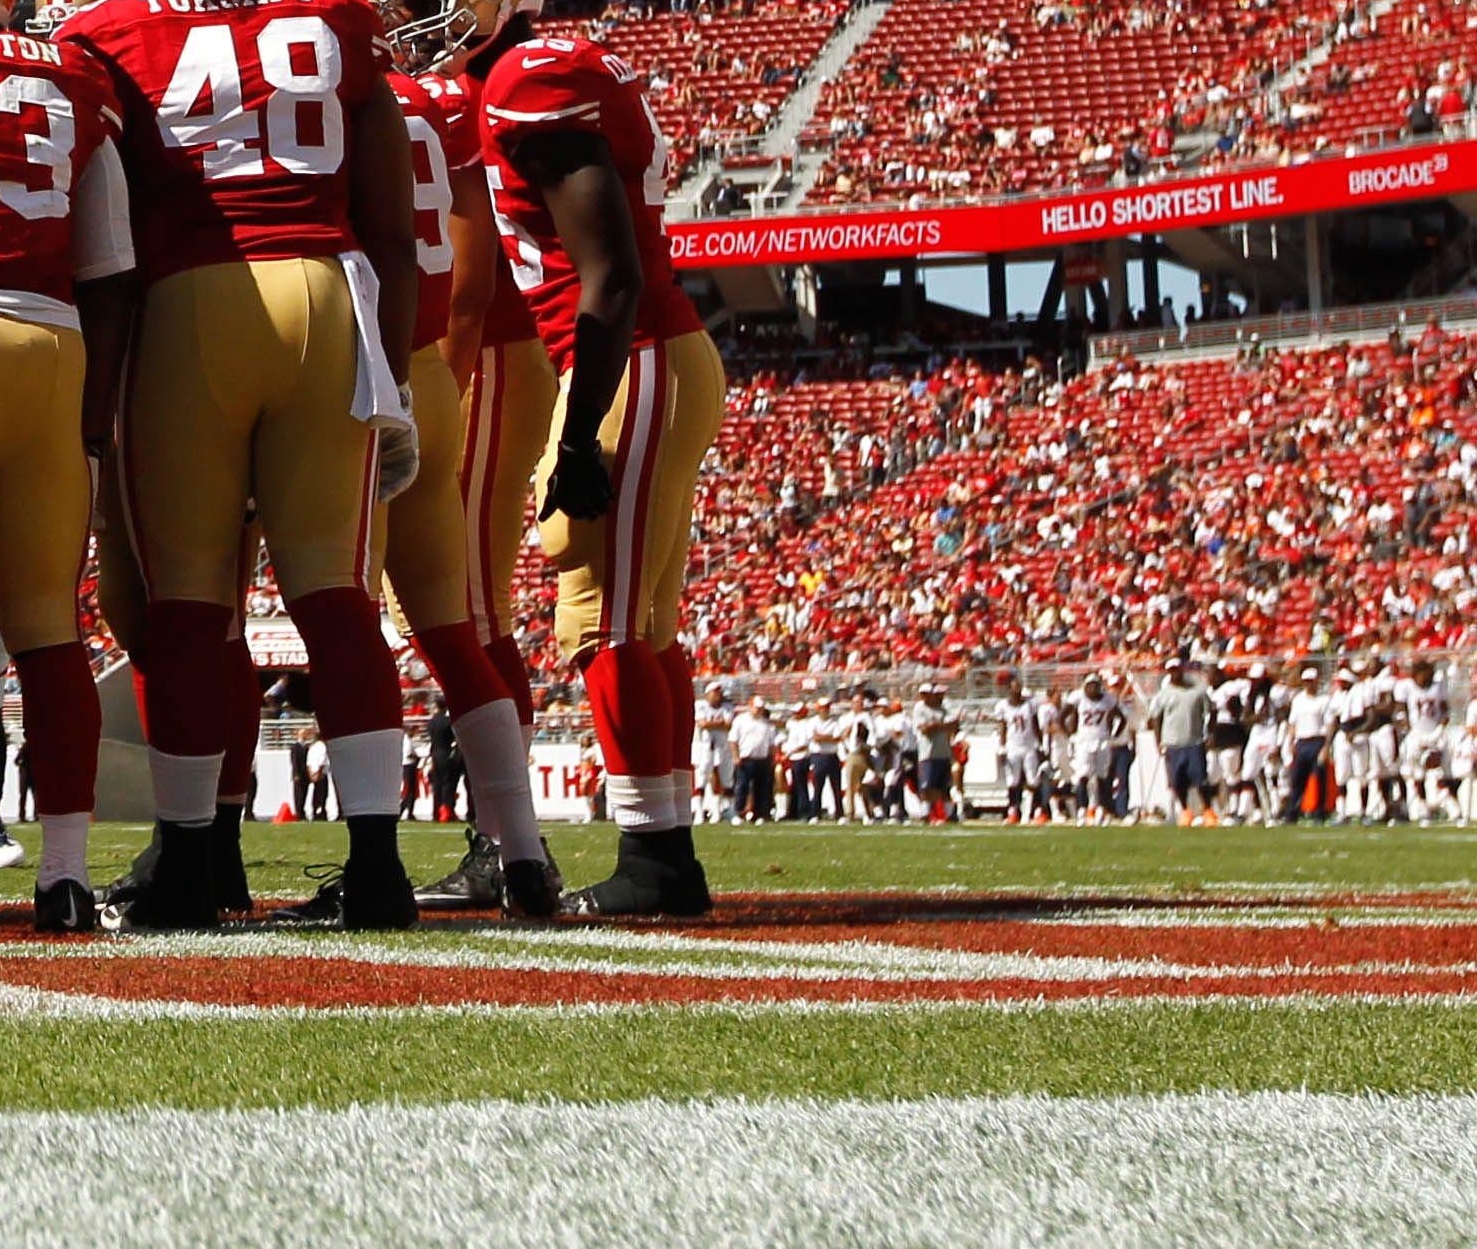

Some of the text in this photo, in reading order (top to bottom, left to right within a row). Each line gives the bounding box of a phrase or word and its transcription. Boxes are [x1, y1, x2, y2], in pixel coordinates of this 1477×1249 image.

[154, 15, 344, 180] 48
[1348, 160, 1436, 196] BROCADE
[1041, 176, 1285, 235] HELLO SHORTEST LINE.
[669, 219, 941, 259] DE.COM/NETWORKFACTS
